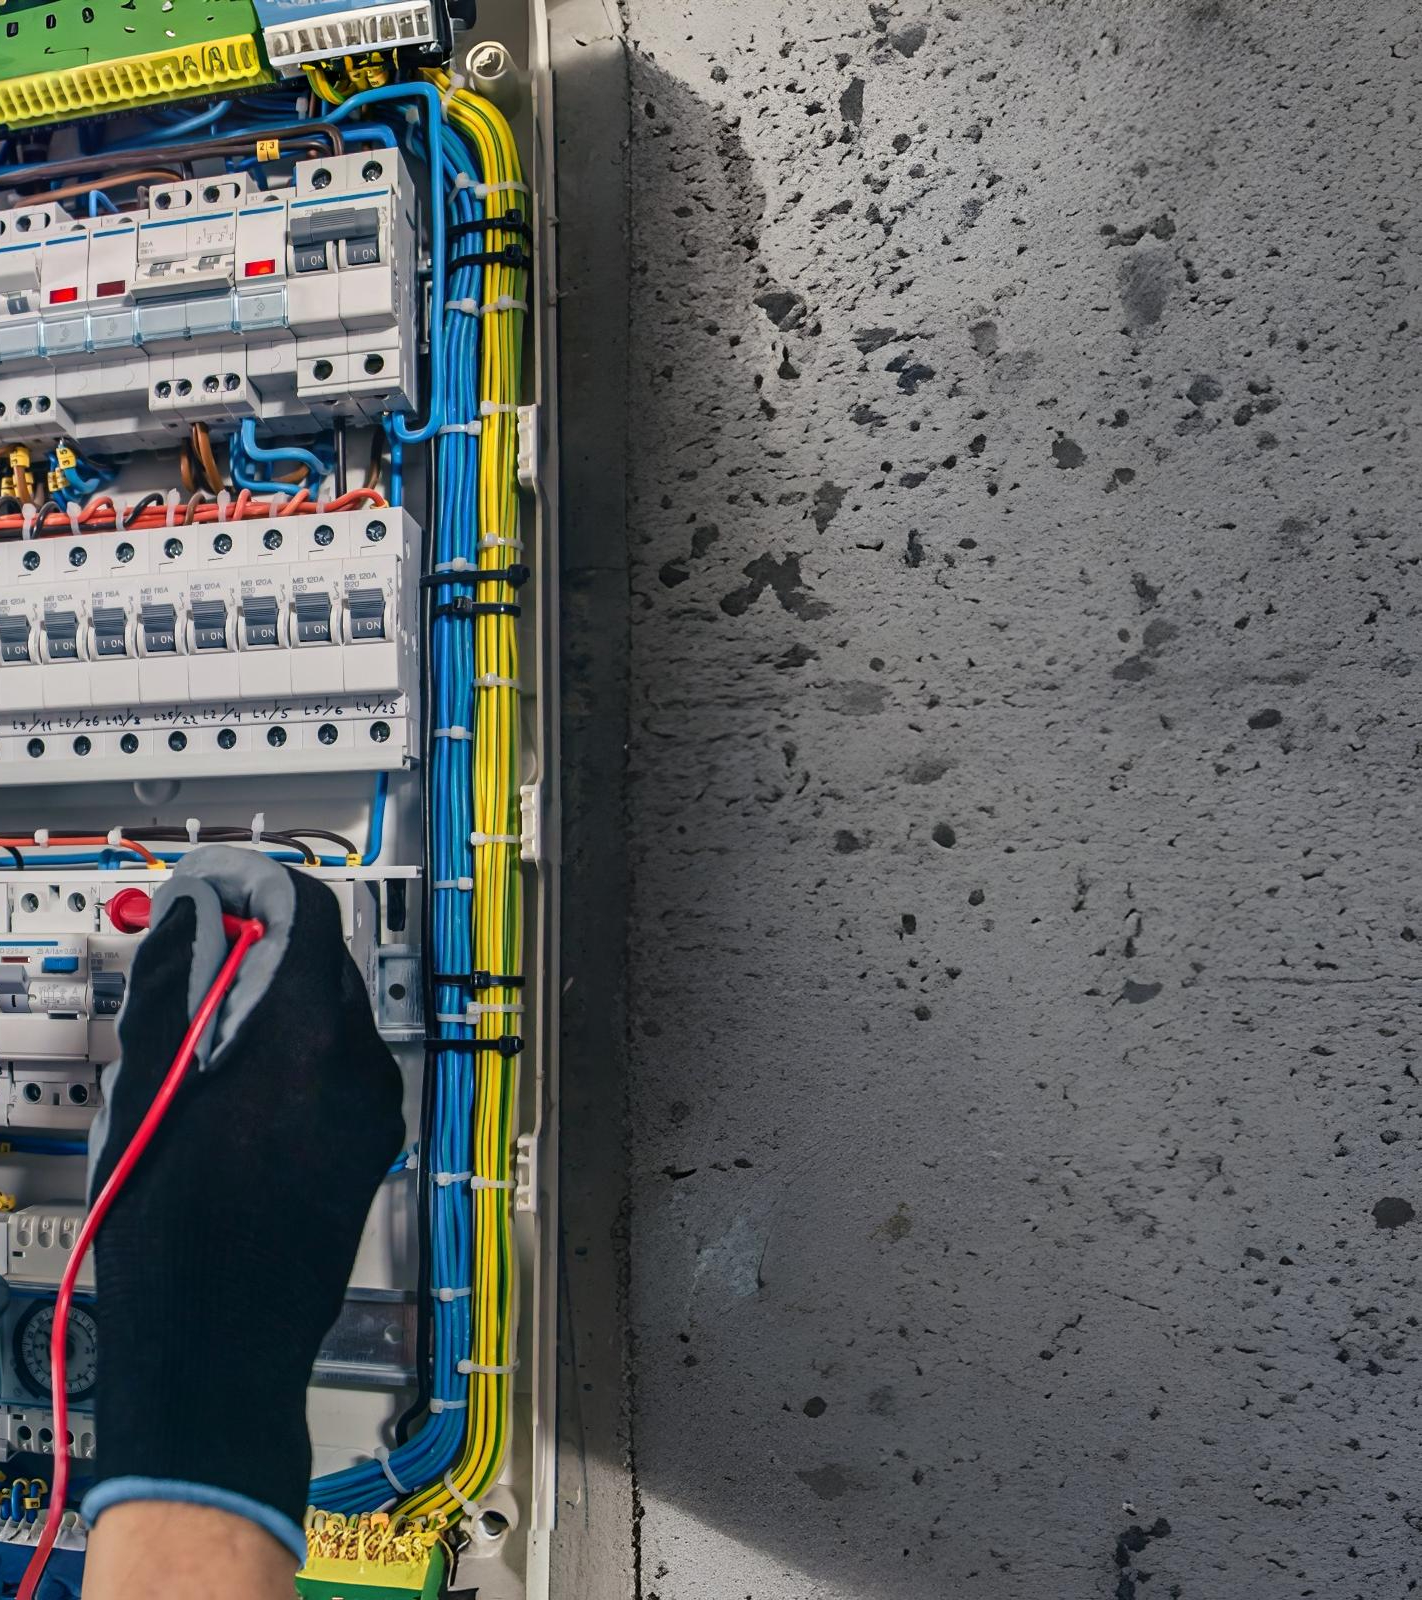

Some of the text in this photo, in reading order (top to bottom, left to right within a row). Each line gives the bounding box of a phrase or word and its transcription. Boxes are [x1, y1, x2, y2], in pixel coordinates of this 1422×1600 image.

[362, 248, 377, 260] ON
[310, 255, 324, 266] ON
[314, 624, 328, 634] ON
[366, 620, 381, 631] ON
